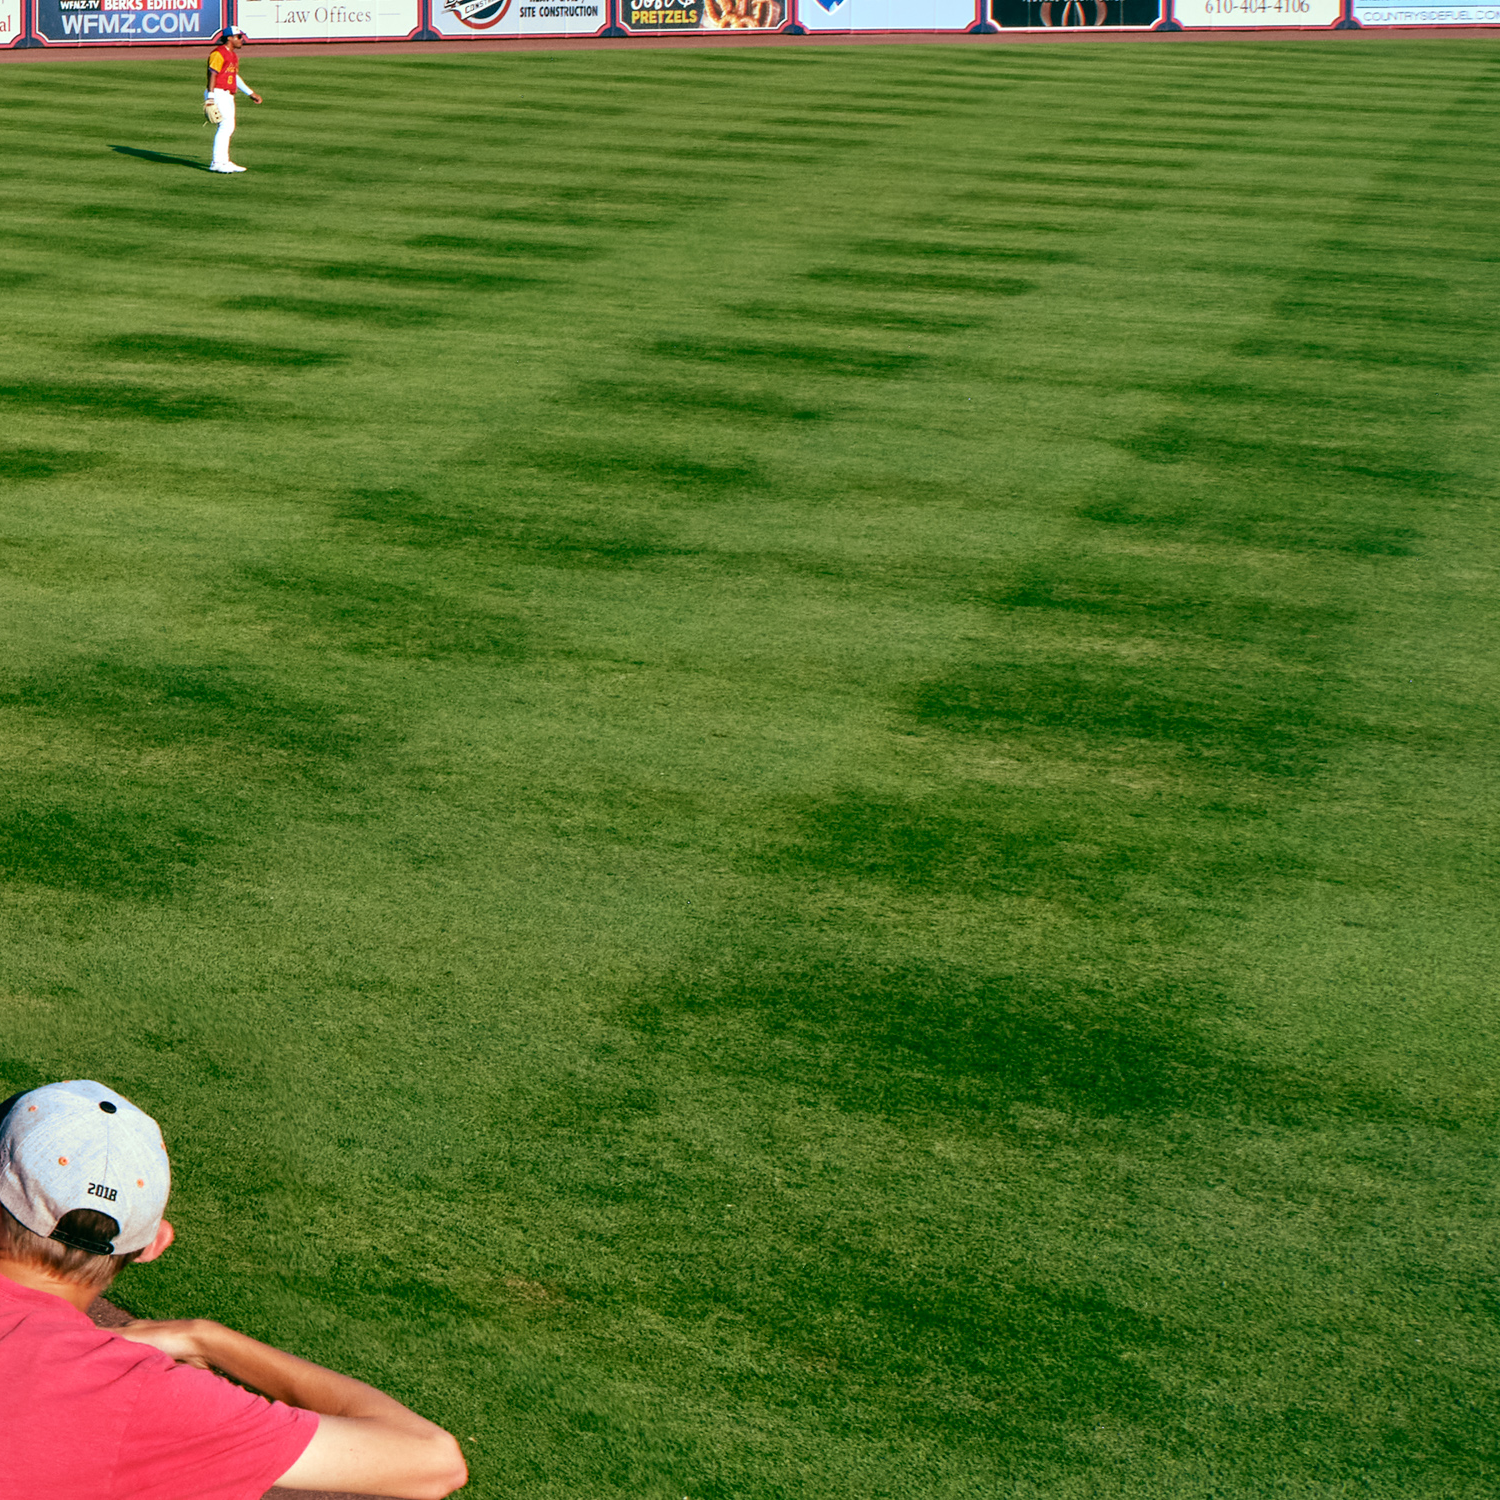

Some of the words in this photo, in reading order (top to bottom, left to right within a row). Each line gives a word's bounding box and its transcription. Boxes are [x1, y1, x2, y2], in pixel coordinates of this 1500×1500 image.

[62, 12, 200, 34] WFMZ.COM
[274, 5, 308, 25] Law
[313, 5, 372, 24] Offices
[632, 10, 697, 25] PRETZELS
[88, 1182, 117, 1202] 2018
